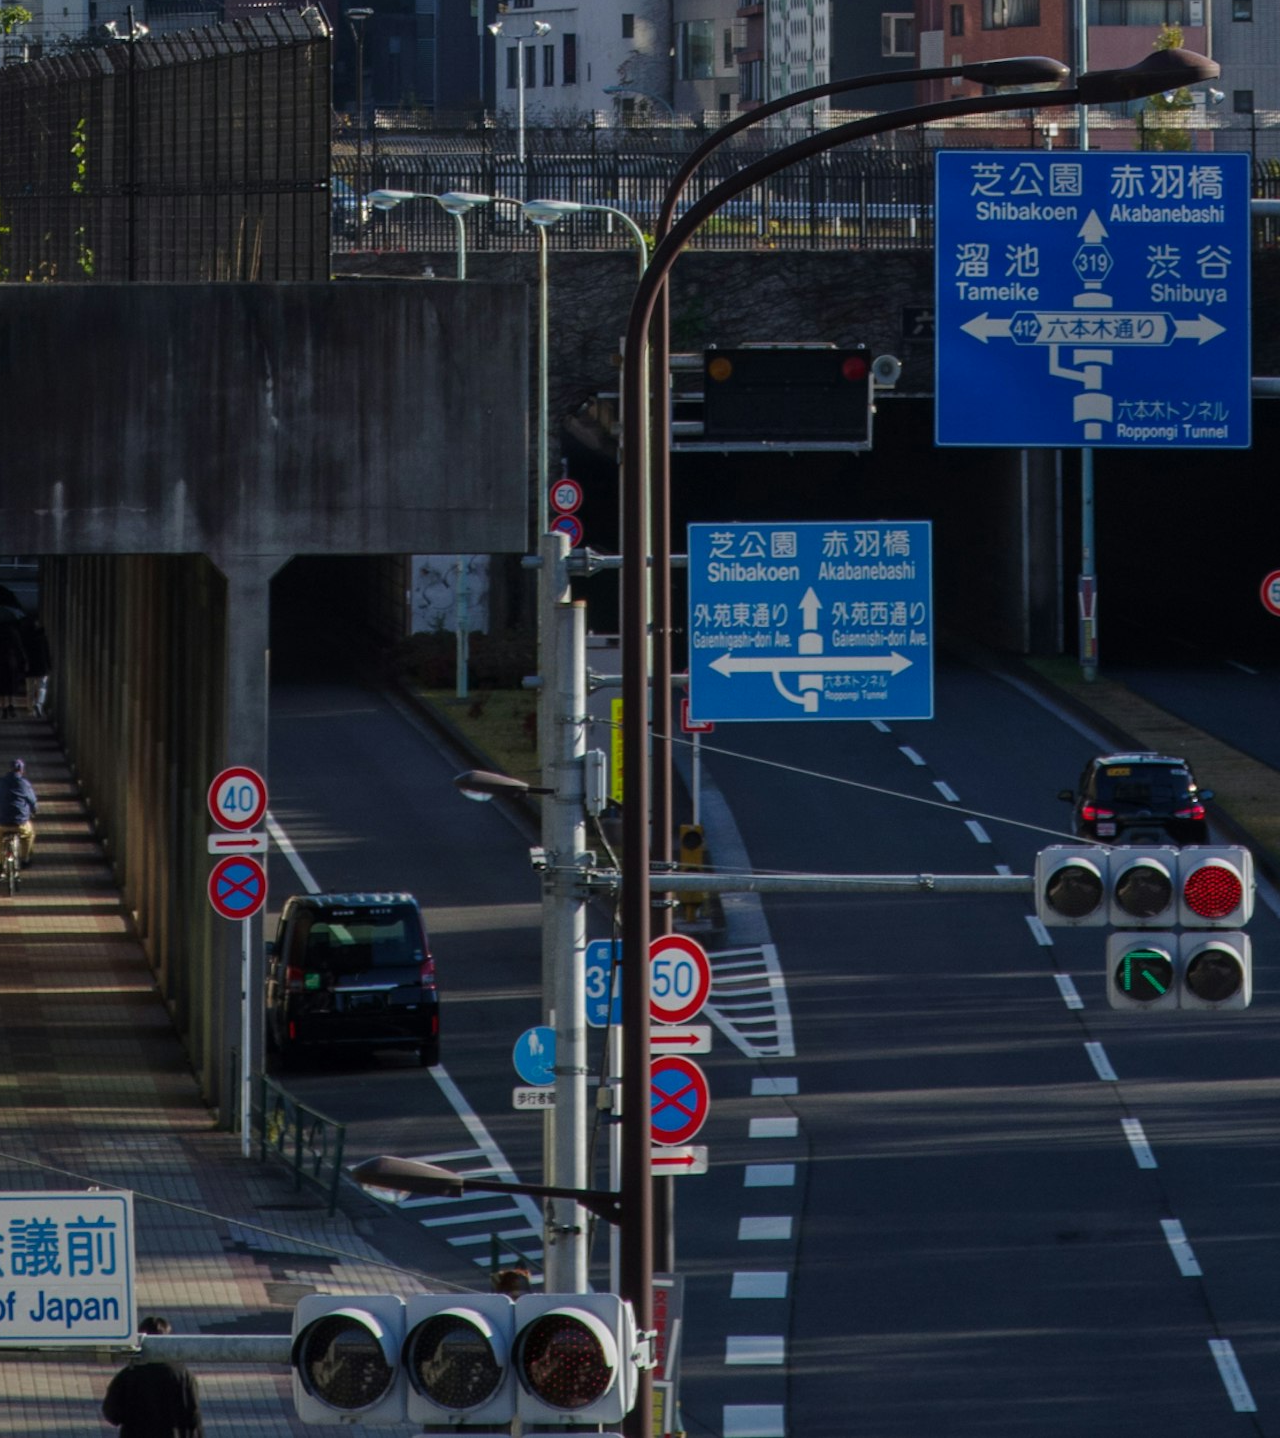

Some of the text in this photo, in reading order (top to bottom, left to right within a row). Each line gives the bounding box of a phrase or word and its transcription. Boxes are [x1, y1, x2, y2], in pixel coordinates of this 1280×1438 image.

[970, 162, 1224, 199] 芝公園 赤羽橋
[976, 201, 1225, 223] Shibakoen Akabanebashi
[1078, 255, 1108, 272] 319
[1146, 244, 1232, 279] 渋谷
[956, 282, 1039, 301] Tameike
[1151, 284, 1228, 305] Shibuya
[1013, 320, 1038, 336] 412
[1047, 318, 1155, 340] 六本木通り
[1117, 400, 1230, 422] 六本木トンネル
[1117, 423, 1229, 441] Roppongi Tunnel
[557, 489, 576, 504] 50
[709, 530, 911, 559] 芝公園 赤羽橋
[707, 560, 916, 582] Shibakoen Akabanebashi
[693, 602, 789, 628] 外苑東通り
[831, 601, 926, 627] 外苑西通り
[693, 630, 793, 651] Gaienhigashi-dori Ave.
[832, 629, 928, 648] Gaiennishi-dori Ave.
[223, 785, 254, 813] 40
[652, 961, 693, 998] 50
[29, 1289, 120, 1329] Japan
